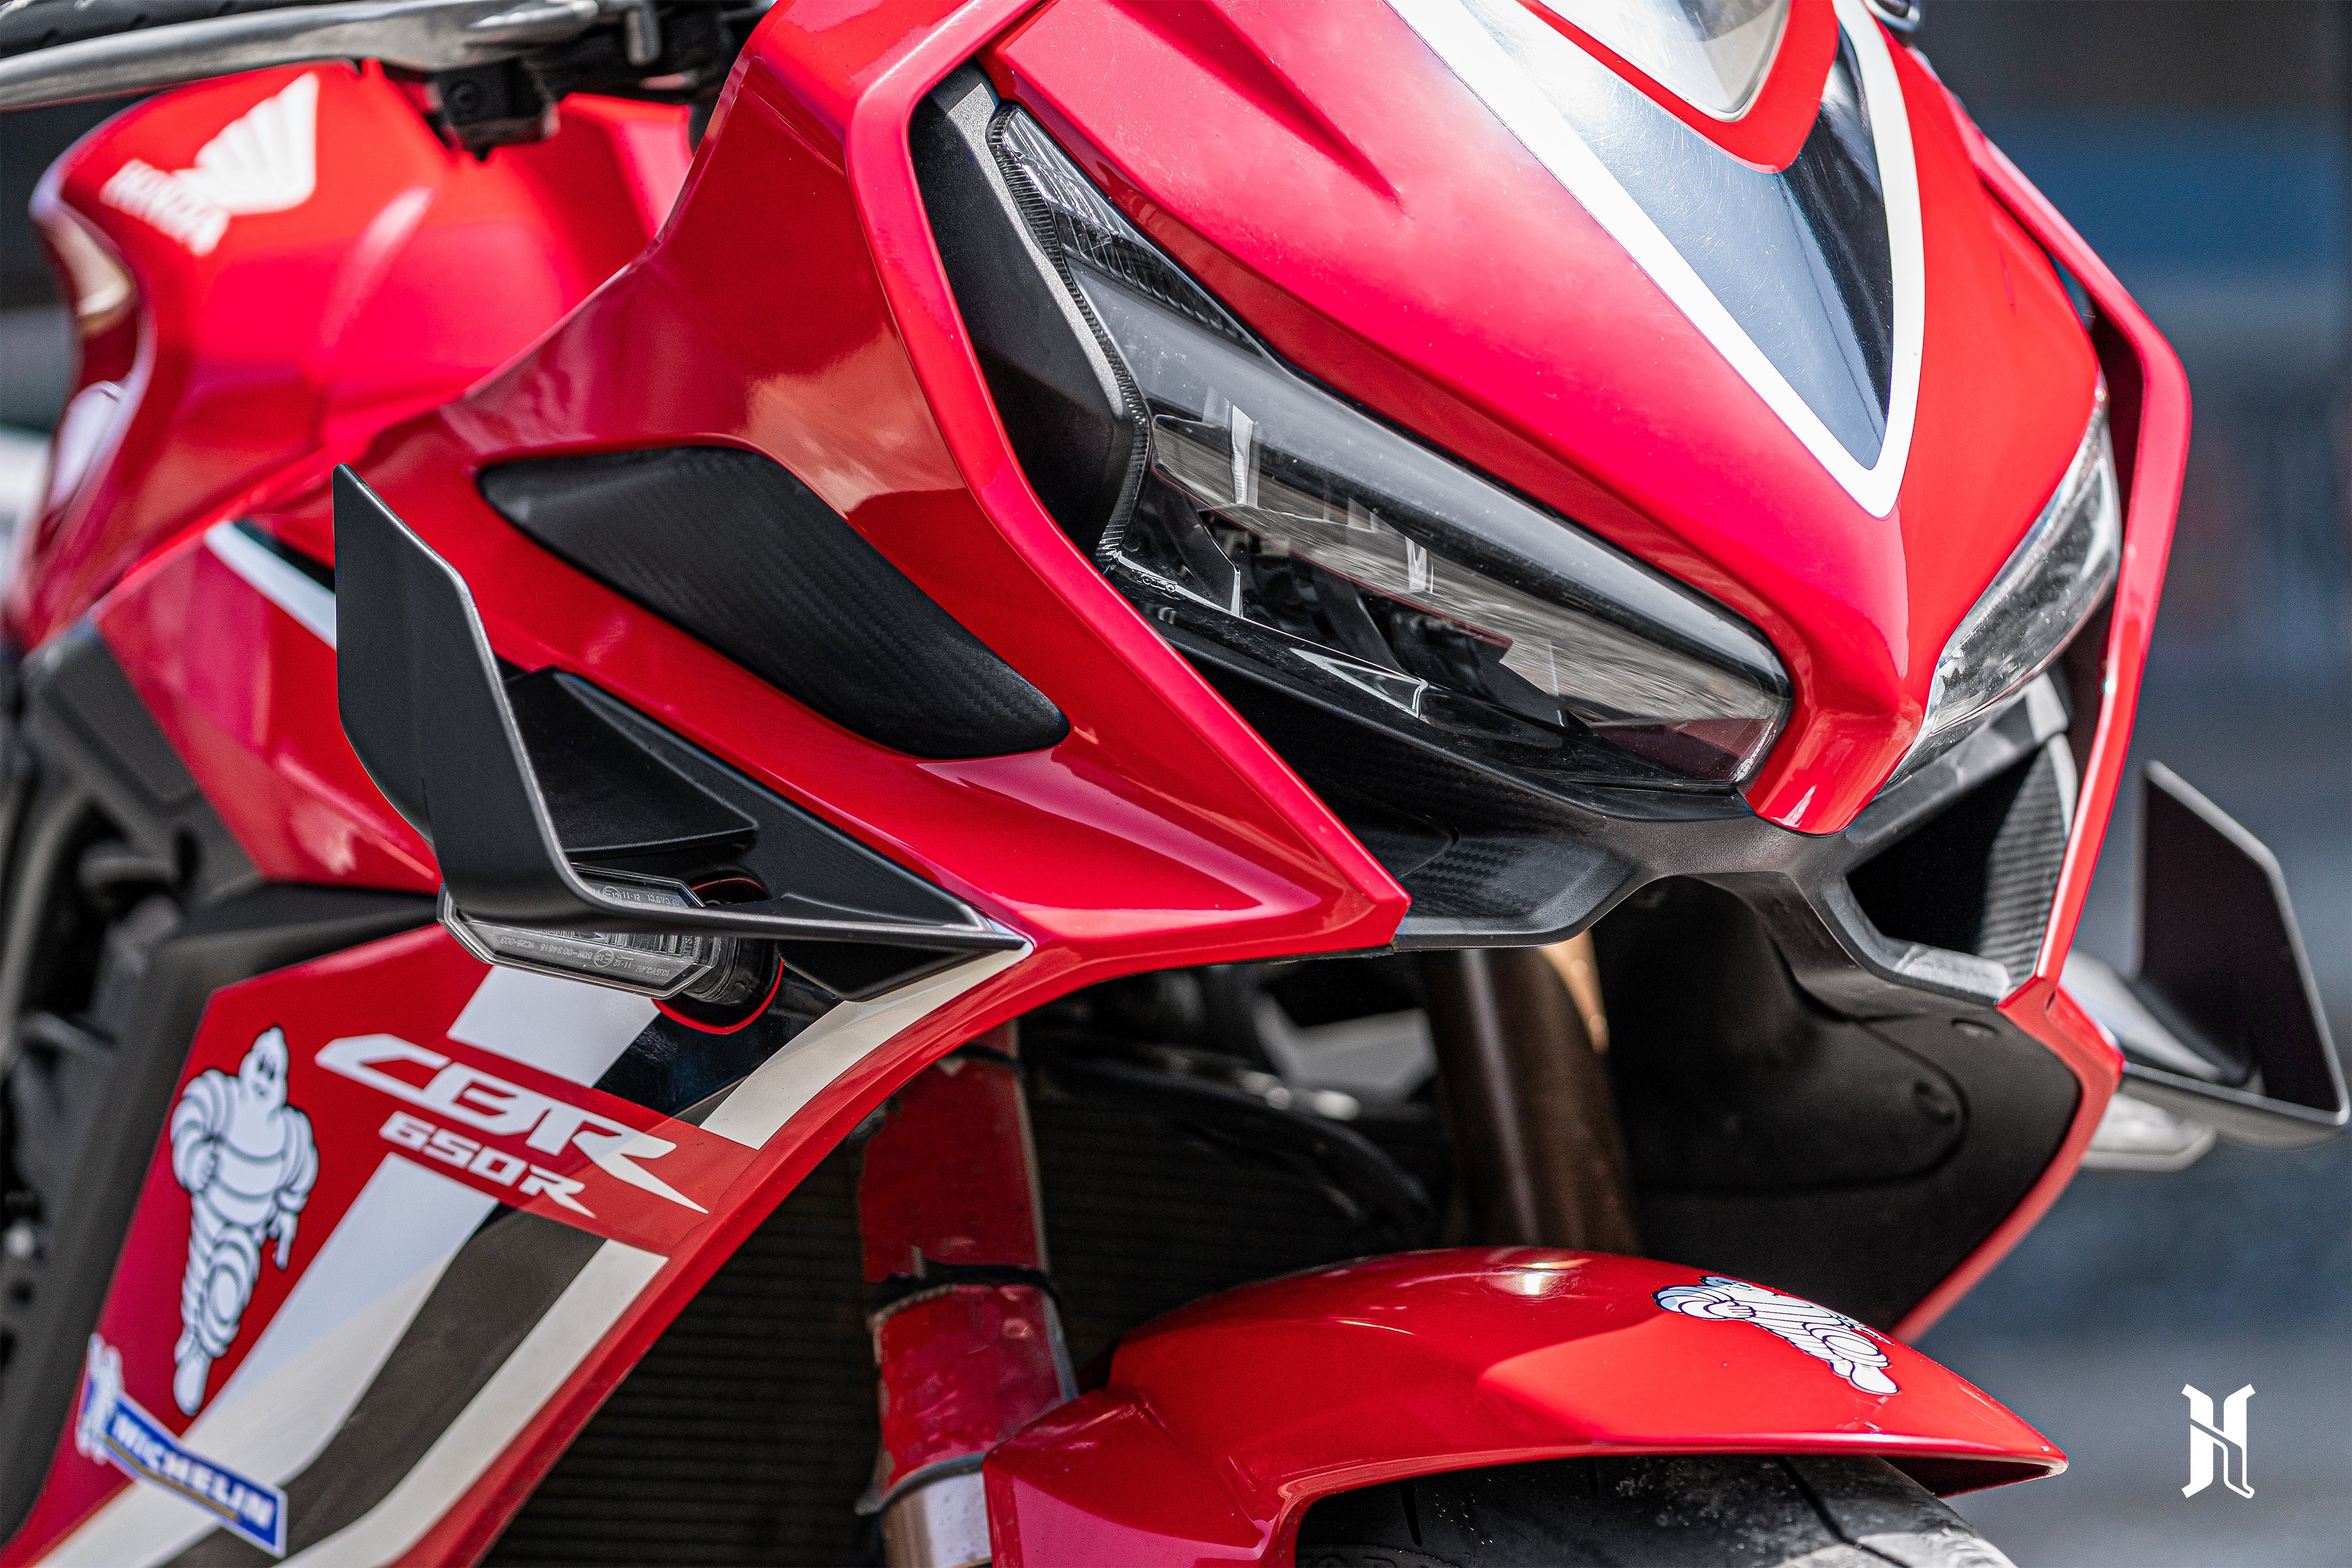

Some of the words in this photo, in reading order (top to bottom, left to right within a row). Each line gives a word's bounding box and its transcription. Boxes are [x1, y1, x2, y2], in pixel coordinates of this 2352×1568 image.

[315, 1033, 709, 1214] CBR
[379, 1111, 597, 1219] 650R
[110, 1415, 275, 1531] MICHELIN
